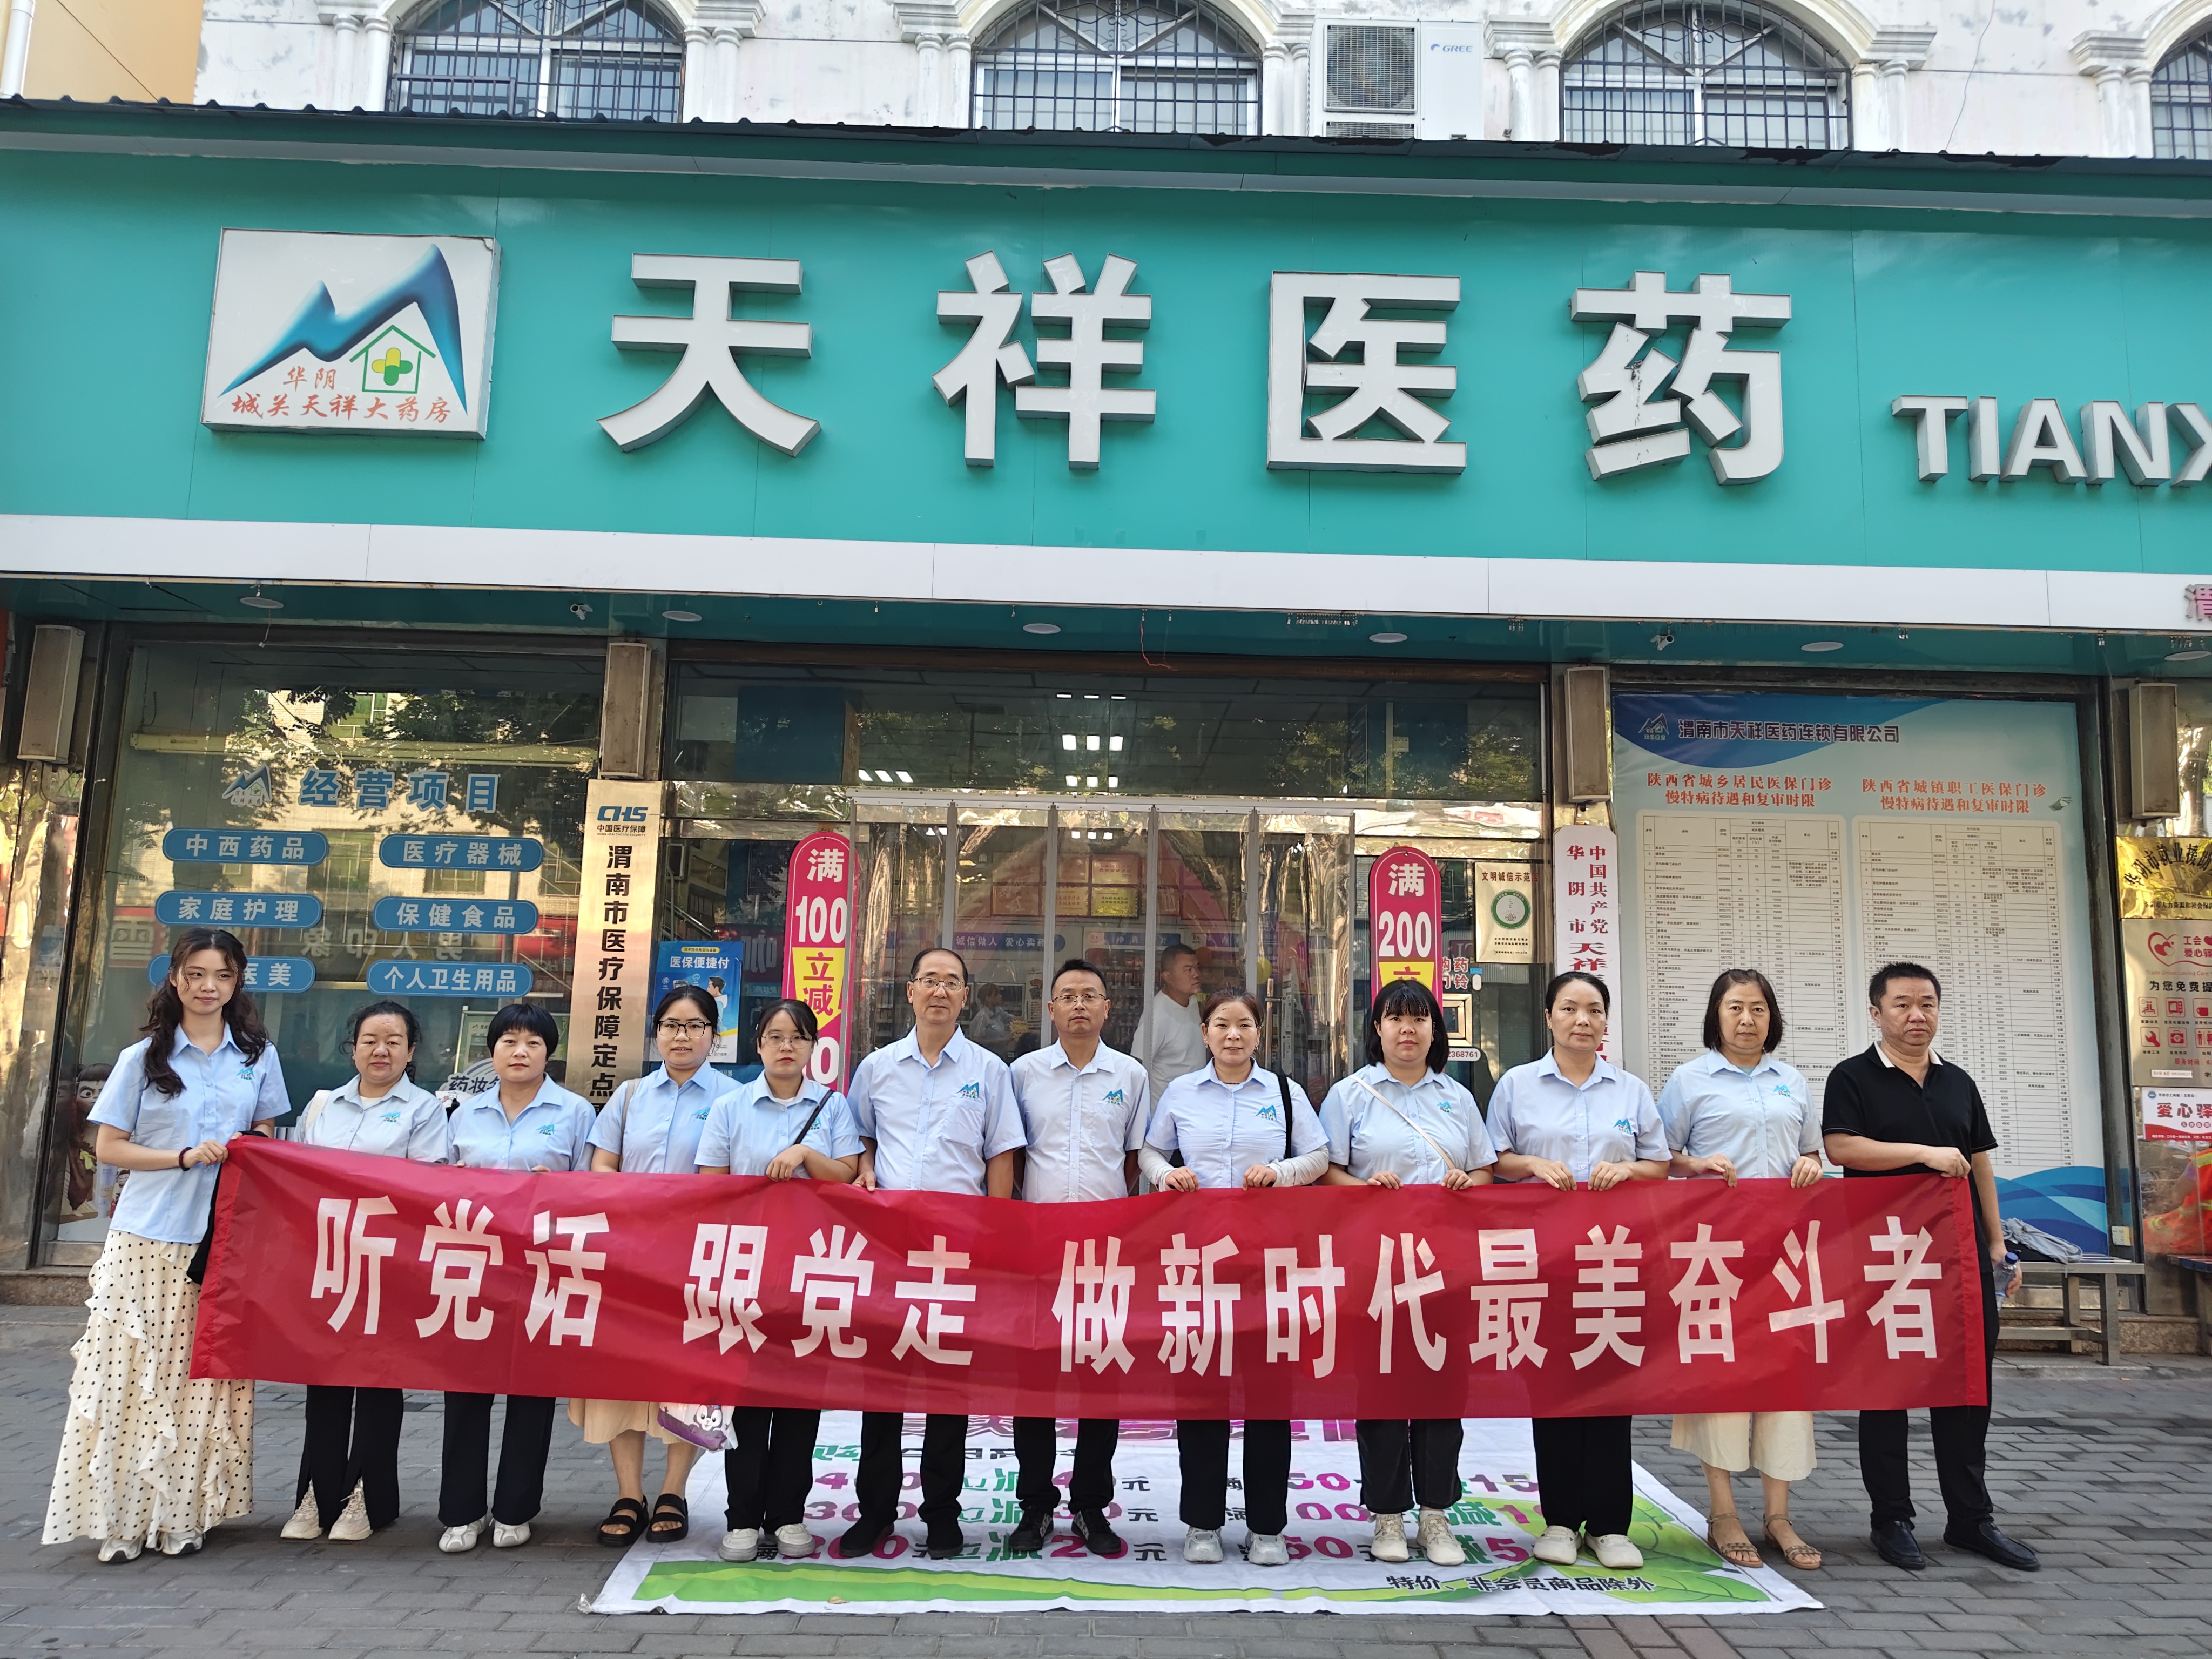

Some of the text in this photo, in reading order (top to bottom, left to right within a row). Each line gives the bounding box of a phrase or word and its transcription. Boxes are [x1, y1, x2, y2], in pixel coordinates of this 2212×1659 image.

[282, 366, 336, 392] 华阴
[597, 250, 1791, 485] 天祥医药
[231, 392, 451, 423] 城关天祥大药房
[1678, 719, 1899, 743] 渭南市天祥医药连锁有限公司
[299, 767, 498, 813] 经营项目
[1647, 772, 1832, 792] 陕西省城乡居民医保门诊
[1862, 778, 2047, 798] 陕西省城镇职工医保门诊
[1665, 789, 1815, 807] 慢特病待遇和复审时限
[1880, 795, 2031, 814] 慢特病待遇和复审时限
[597, 806, 649, 822] CHS
[597, 824, 646, 833] 中国医疗保障
[186, 833, 304, 859] 中西药品
[403, 840, 522, 866] 医疗器械
[807, 848, 845, 882] 满
[1481, 871, 1539, 882] 文明诚信示范店
[1388, 863, 1425, 896] 满
[1567, 845, 1587, 933] 华阴市
[1589, 845, 1608, 934] 中国共产党
[178, 896, 299, 922] 家庭护理
[397, 902, 516, 929] 保健食品
[795, 896, 847, 943] 100
[955, 936, 998, 946] 诚信做人
[1378, 910, 1432, 957] 200
[2183, 936, 2202, 946] 工会
[670, 956, 730, 969] 医保便捷付
[384, 966, 517, 992] 个人卫生用品
[589, 845, 632, 1107] 渭南市医疗保障定点
[803, 952, 834, 1016] 立减
[309, 1195, 1943, 1380] 听党话 跟党走 做新时代最美奋斗者
[1385, 1574, 1657, 1593] 特价、非会员商品除外
